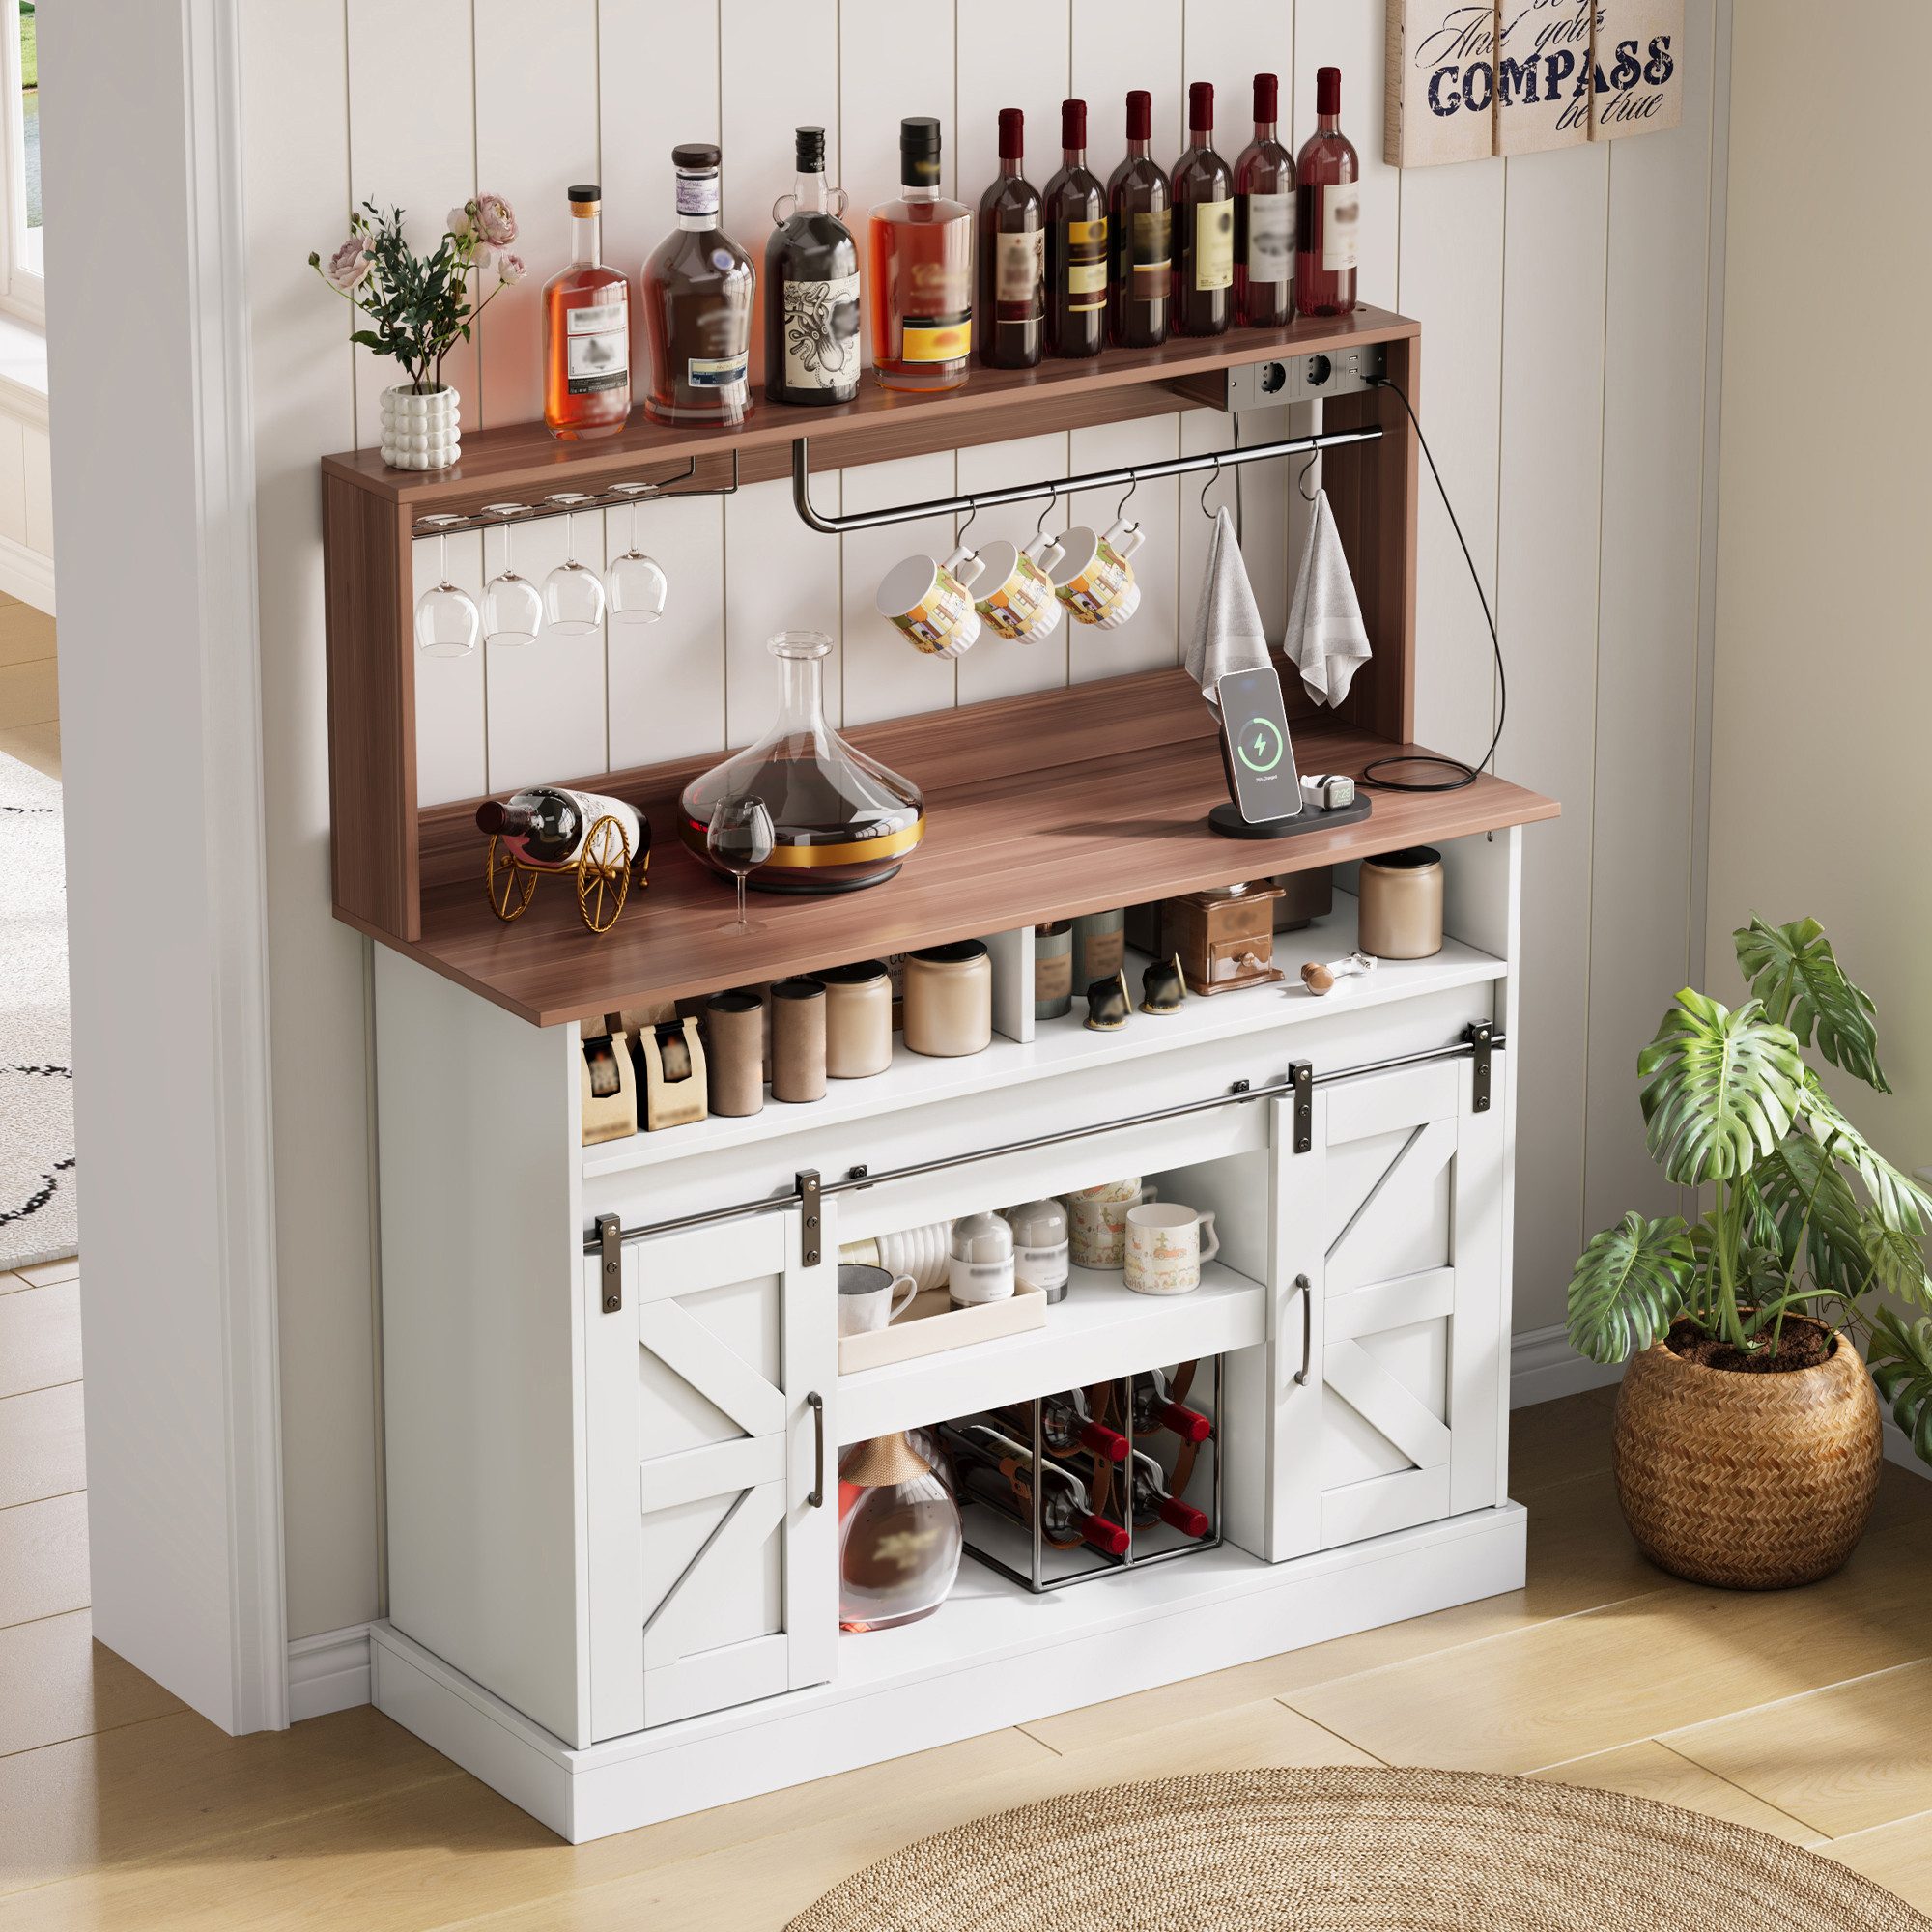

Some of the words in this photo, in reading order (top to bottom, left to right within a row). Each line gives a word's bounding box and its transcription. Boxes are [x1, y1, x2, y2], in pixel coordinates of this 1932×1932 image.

[1414, 7, 1530, 69] And
[1428, 35, 1674, 117] COMPASS
[1555, 95, 1589, 131] be
[1601, 90, 1663, 125] true
